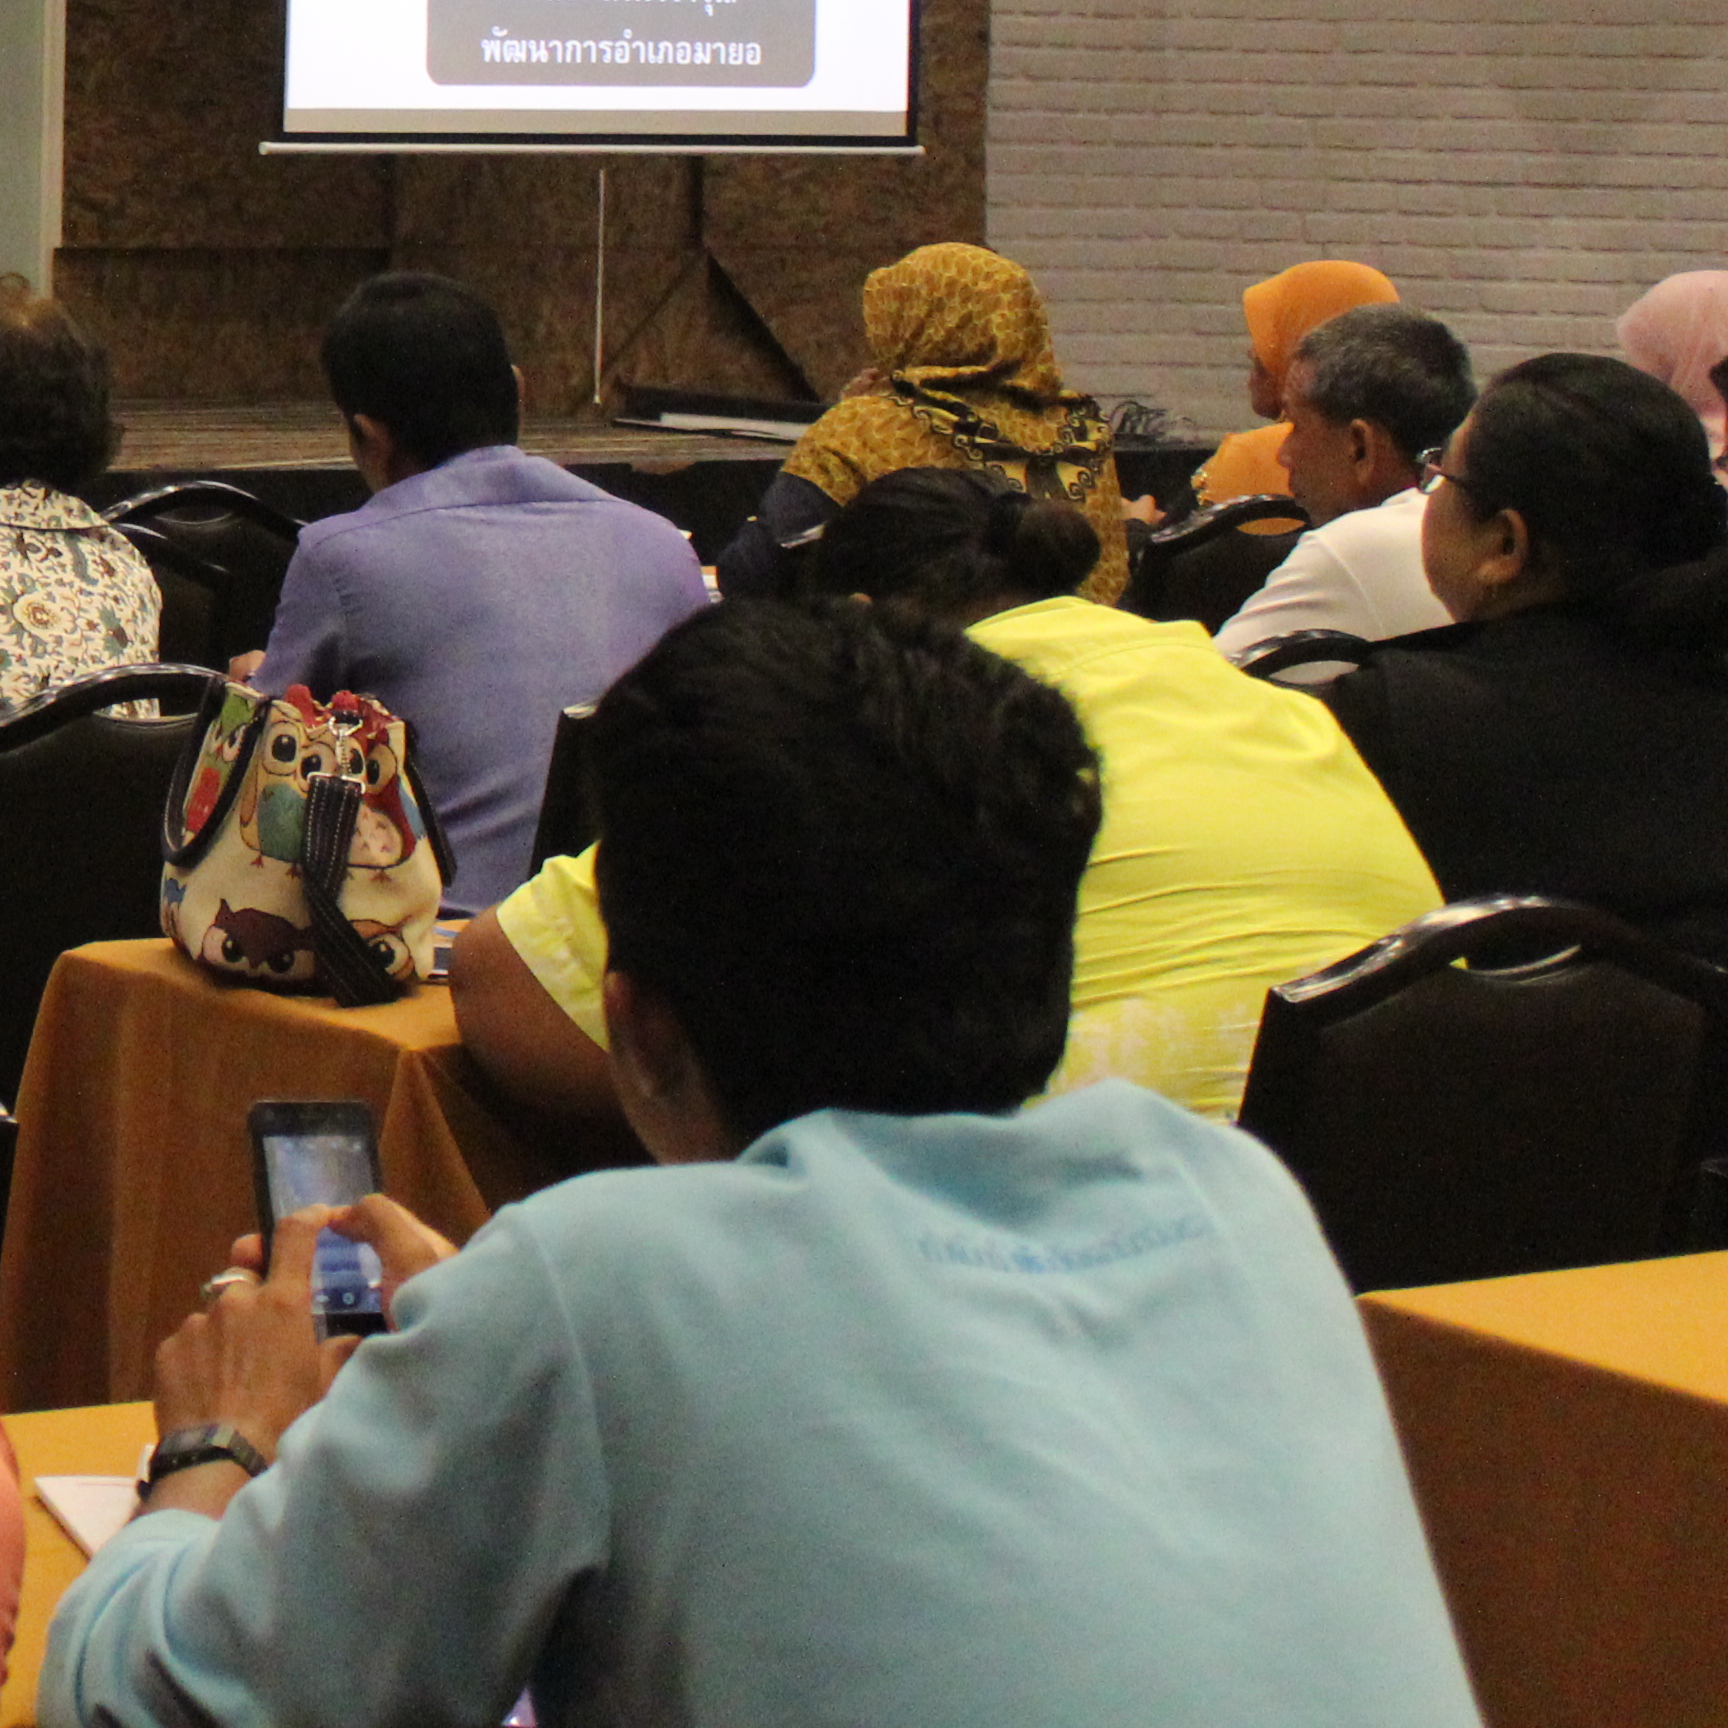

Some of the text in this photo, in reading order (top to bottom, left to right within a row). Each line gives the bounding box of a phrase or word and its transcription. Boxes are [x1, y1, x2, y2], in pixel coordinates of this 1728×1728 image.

[481, 26, 761, 65] พัฒนาการอำเภอมายอ
